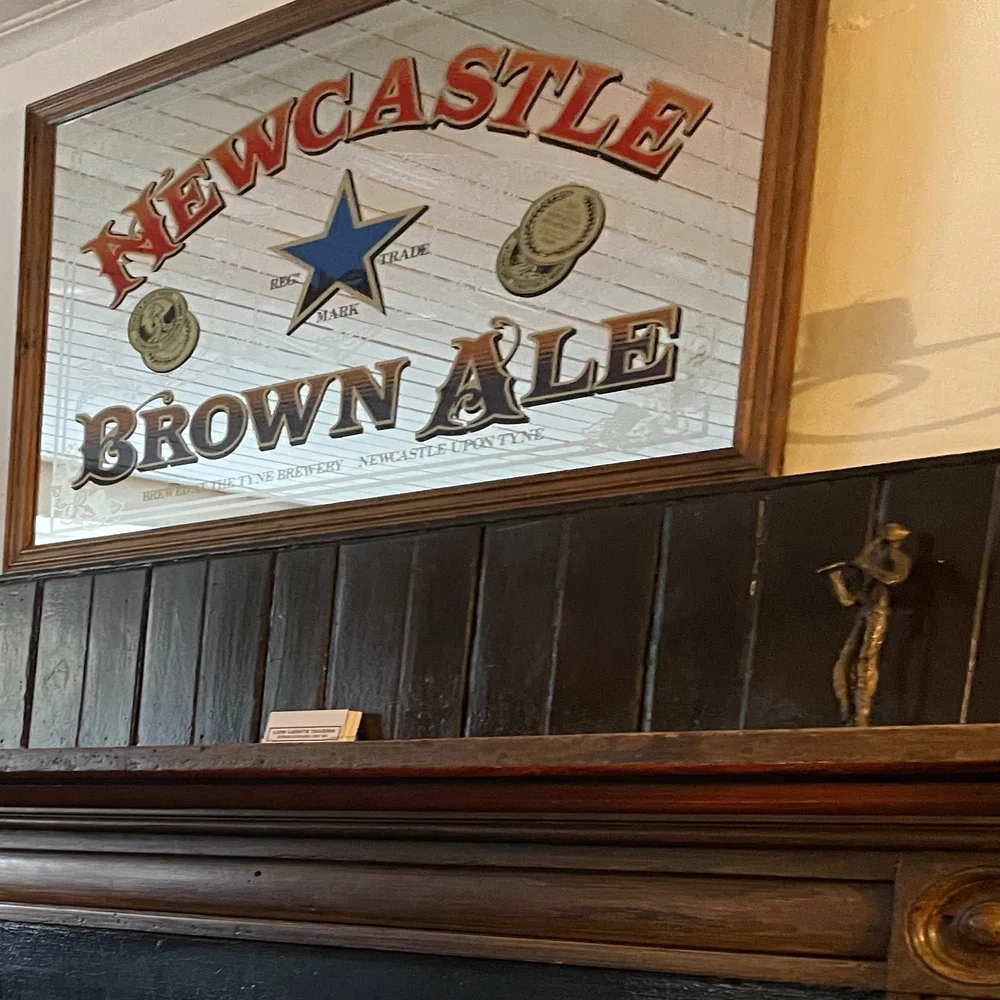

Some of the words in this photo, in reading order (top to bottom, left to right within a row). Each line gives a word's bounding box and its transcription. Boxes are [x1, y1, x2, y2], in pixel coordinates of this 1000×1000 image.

[80, 43, 714, 311] NEWCASTLE
[378, 243, 430, 265] TRADE
[316, 303, 359, 323] MARK
[70, 357, 411, 491] BROWN
[415, 305, 681, 441] ALE
[210, 477, 235, 491] THE
[238, 471, 275, 488] TYNE
[277, 459, 344, 481] BREWERY
[359, 443, 446, 468] NEWCASTLE
[451, 435, 496, 453] UPON
[498, 428, 546, 446] TYNE
